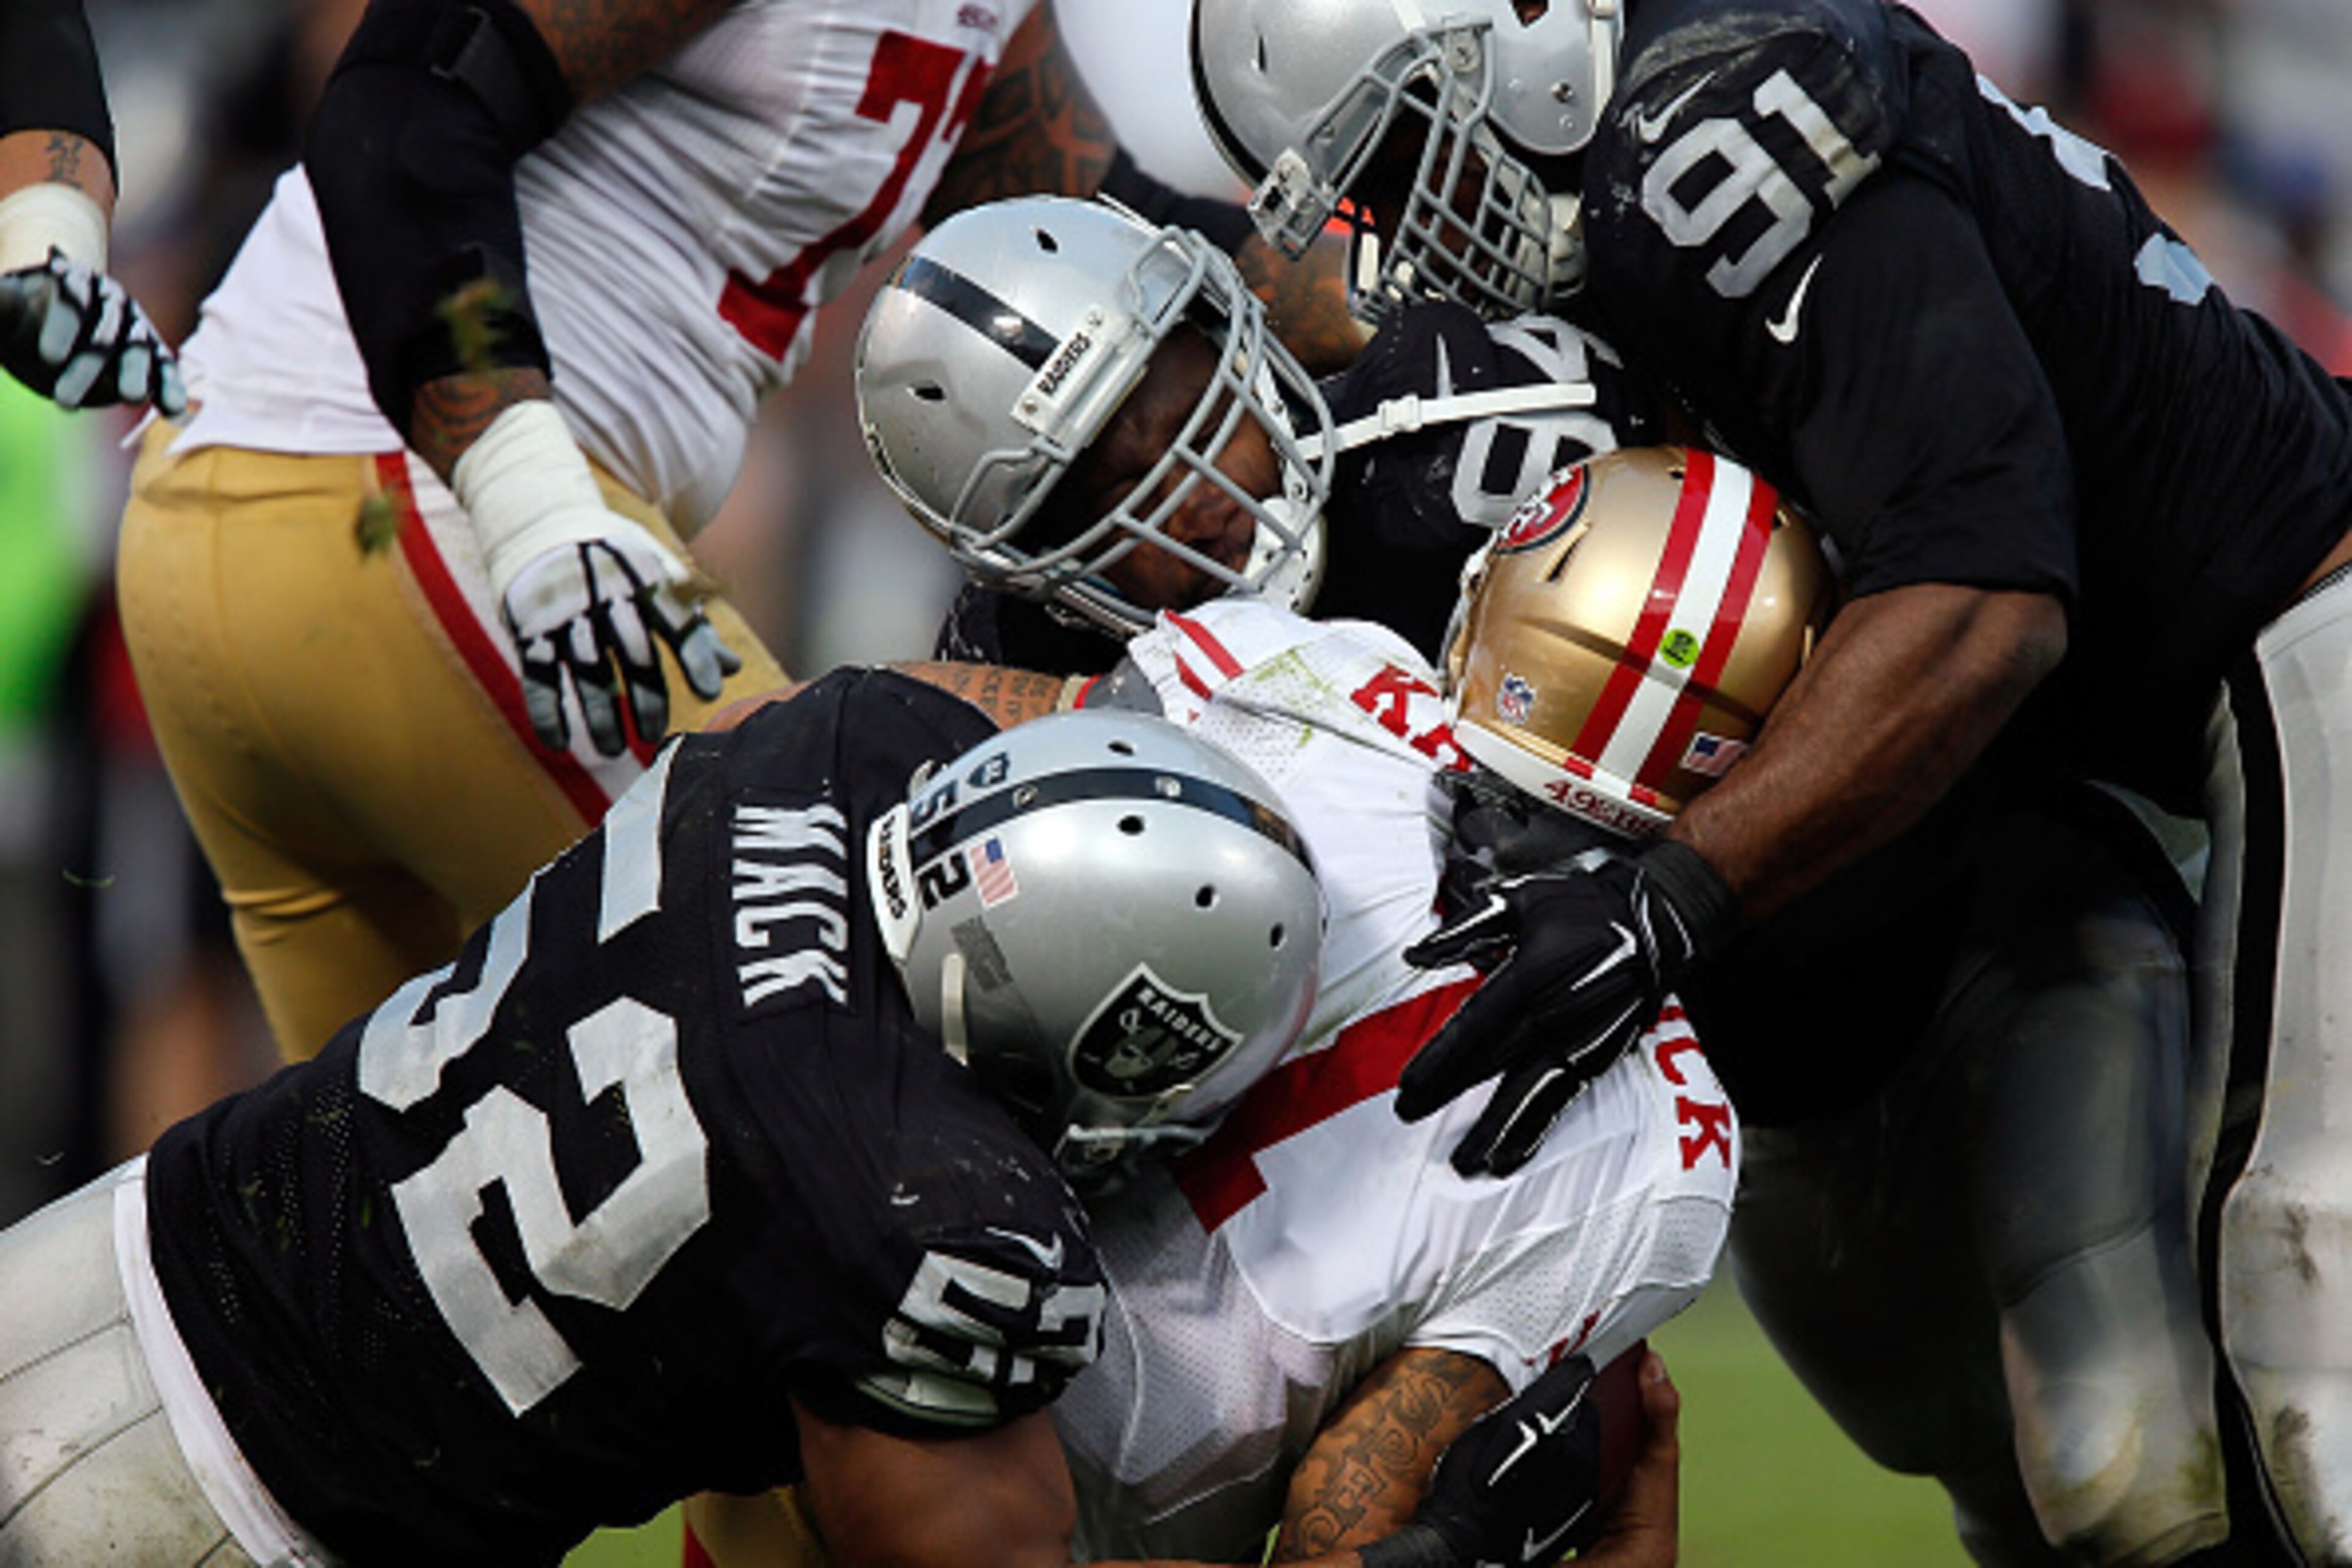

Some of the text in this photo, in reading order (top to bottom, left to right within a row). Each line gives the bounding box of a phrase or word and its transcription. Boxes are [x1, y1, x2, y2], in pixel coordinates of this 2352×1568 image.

[1642, 69, 1882, 298] 91
[1036, 331, 1091, 396] RAIDERS
[731, 802, 848, 1008] MACK
[358, 732, 711, 1418] 52
[1136, 987, 1223, 1052] RAIDERS
